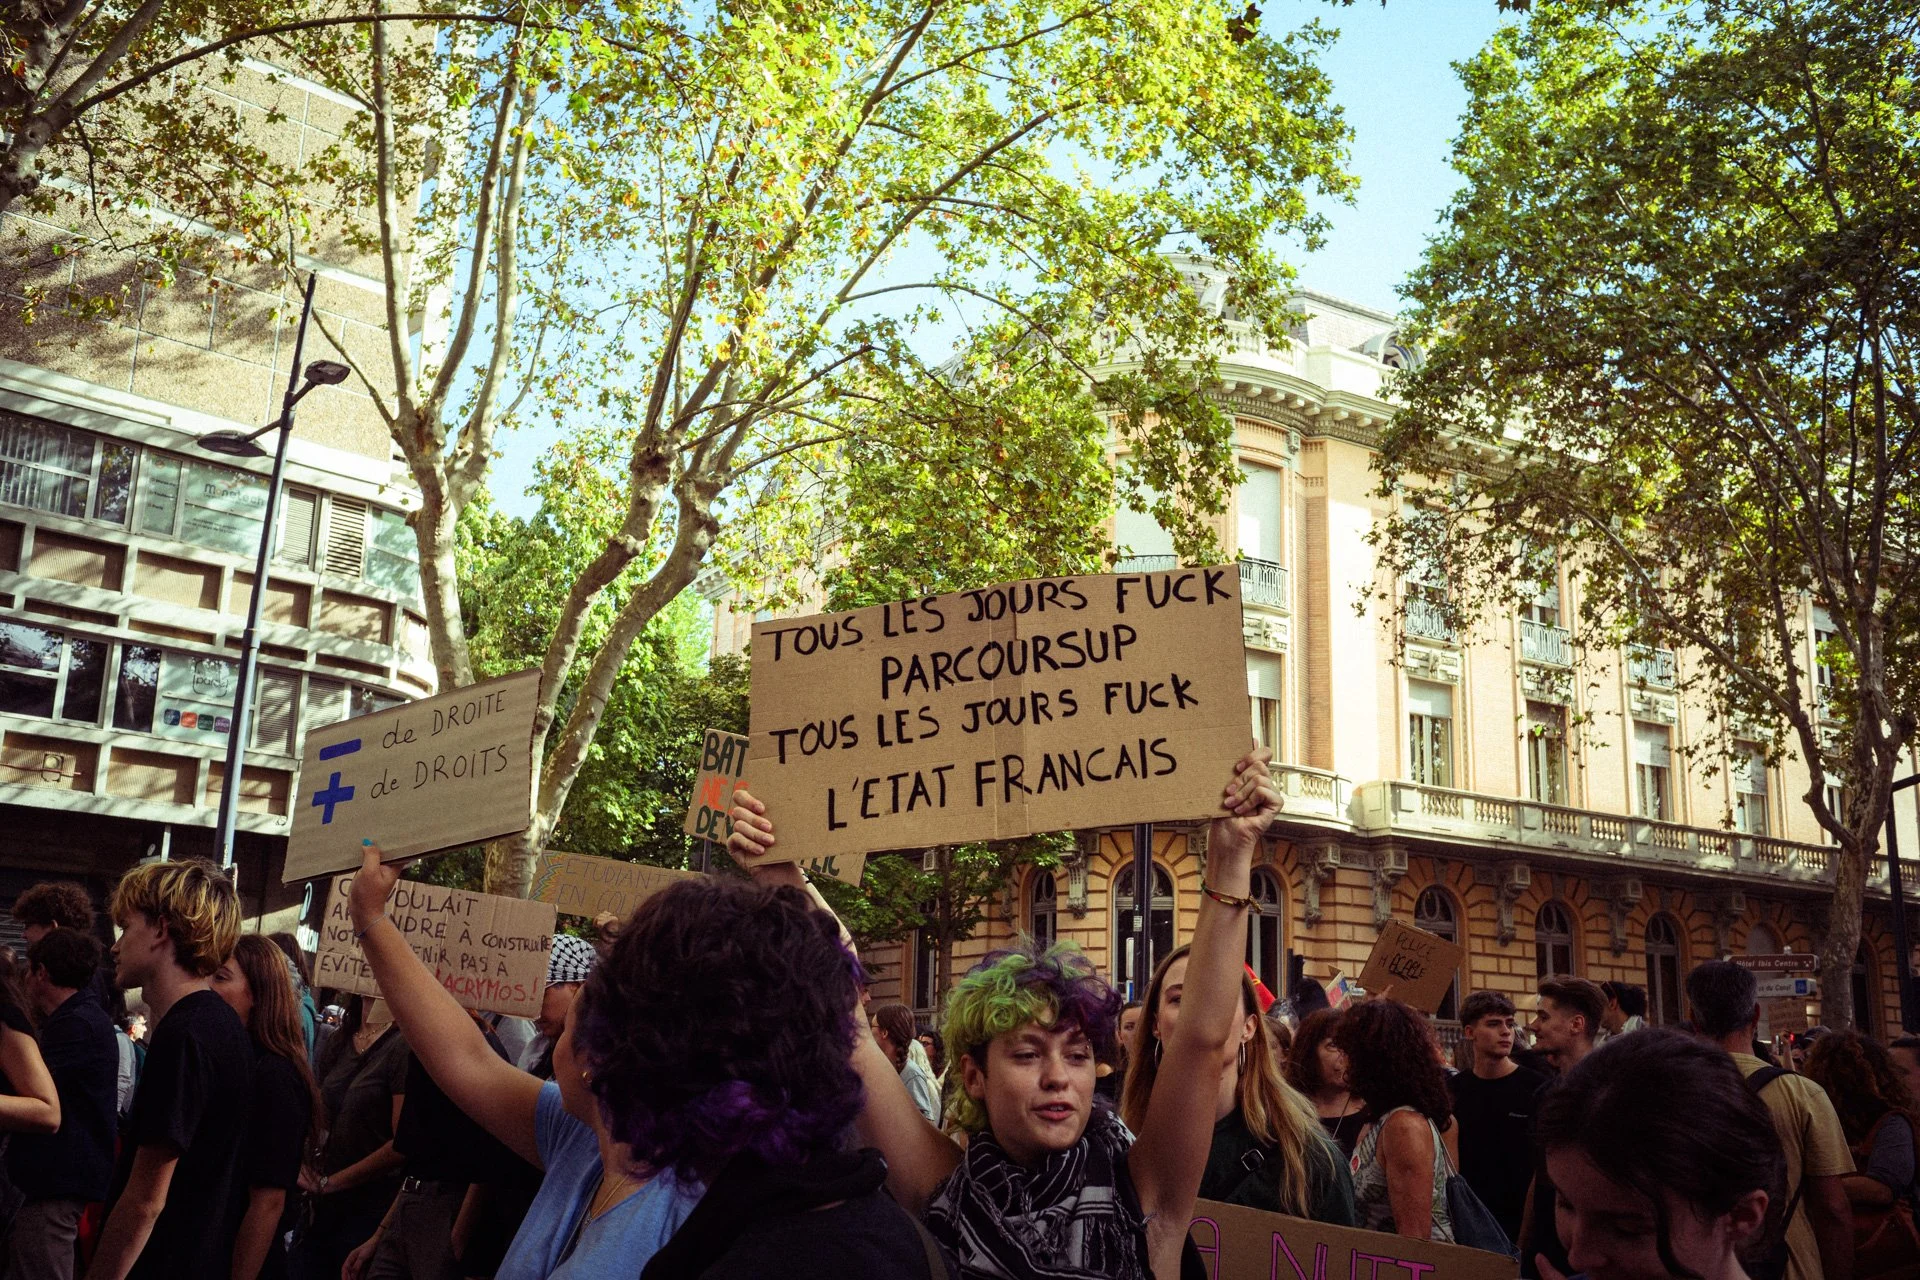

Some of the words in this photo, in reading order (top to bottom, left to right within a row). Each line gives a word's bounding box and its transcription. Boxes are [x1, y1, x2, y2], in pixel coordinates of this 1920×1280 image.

[761, 616, 863, 661] TOUS
[884, 597, 944, 637] LES
[967, 580, 1087, 622] JOURS
[1117, 569, 1232, 613] FUCK
[882, 624, 1136, 700] PARCOURSUP
[383, 719, 417, 749] de
[769, 714, 858, 764] TOUS
[877, 706, 939, 748] LES
[962, 689, 1077, 733] JOURS
[1105, 673, 1198, 715] FUCK
[370, 768, 400, 799] de
[828, 765, 954, 831] L'ETAT
[976, 738, 1176, 806] FRANCAIS
[558, 883, 587, 907] EN
[459, 921, 472, 946] À
[461, 952, 488, 973] PAS
[497, 954, 509, 977] À
